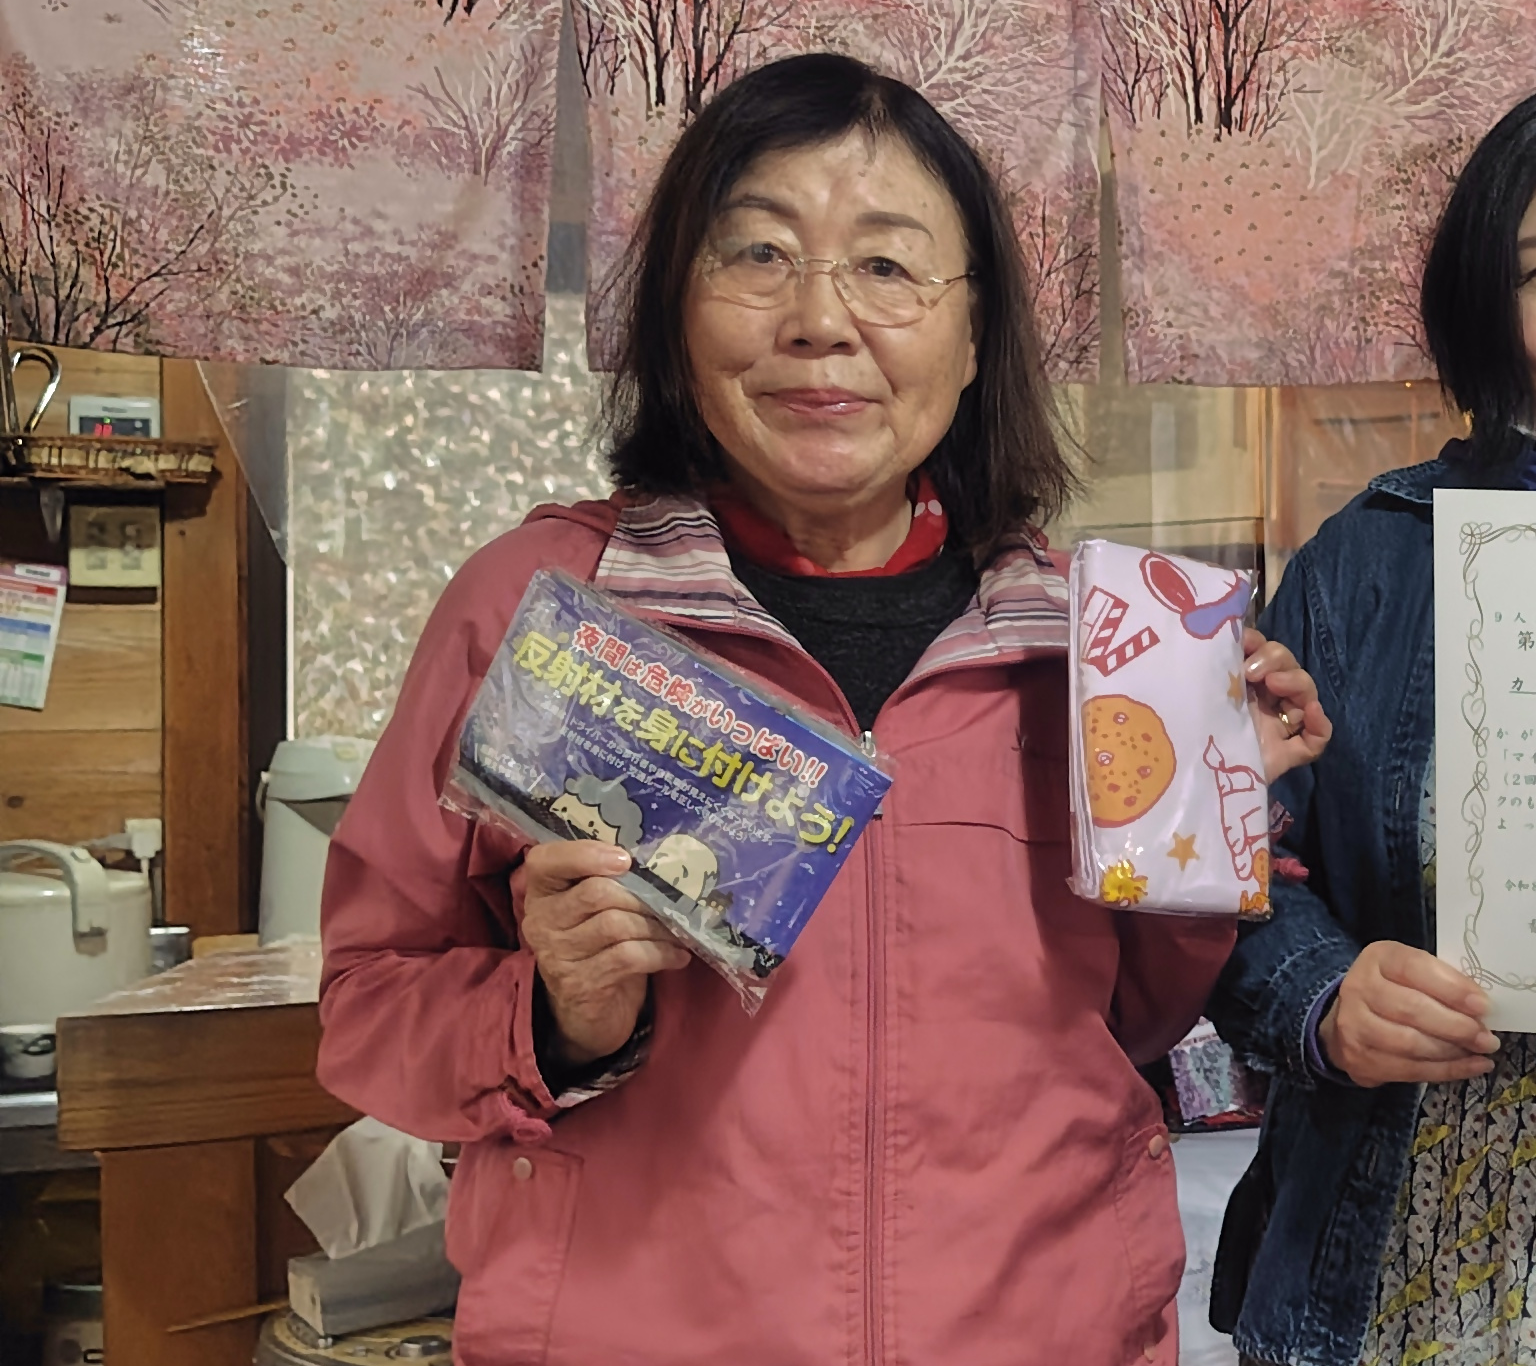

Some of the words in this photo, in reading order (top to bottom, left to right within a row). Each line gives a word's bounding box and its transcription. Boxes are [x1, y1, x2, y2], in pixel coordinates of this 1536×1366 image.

[512, 631, 855, 855] 反射材を身に付けよう!
